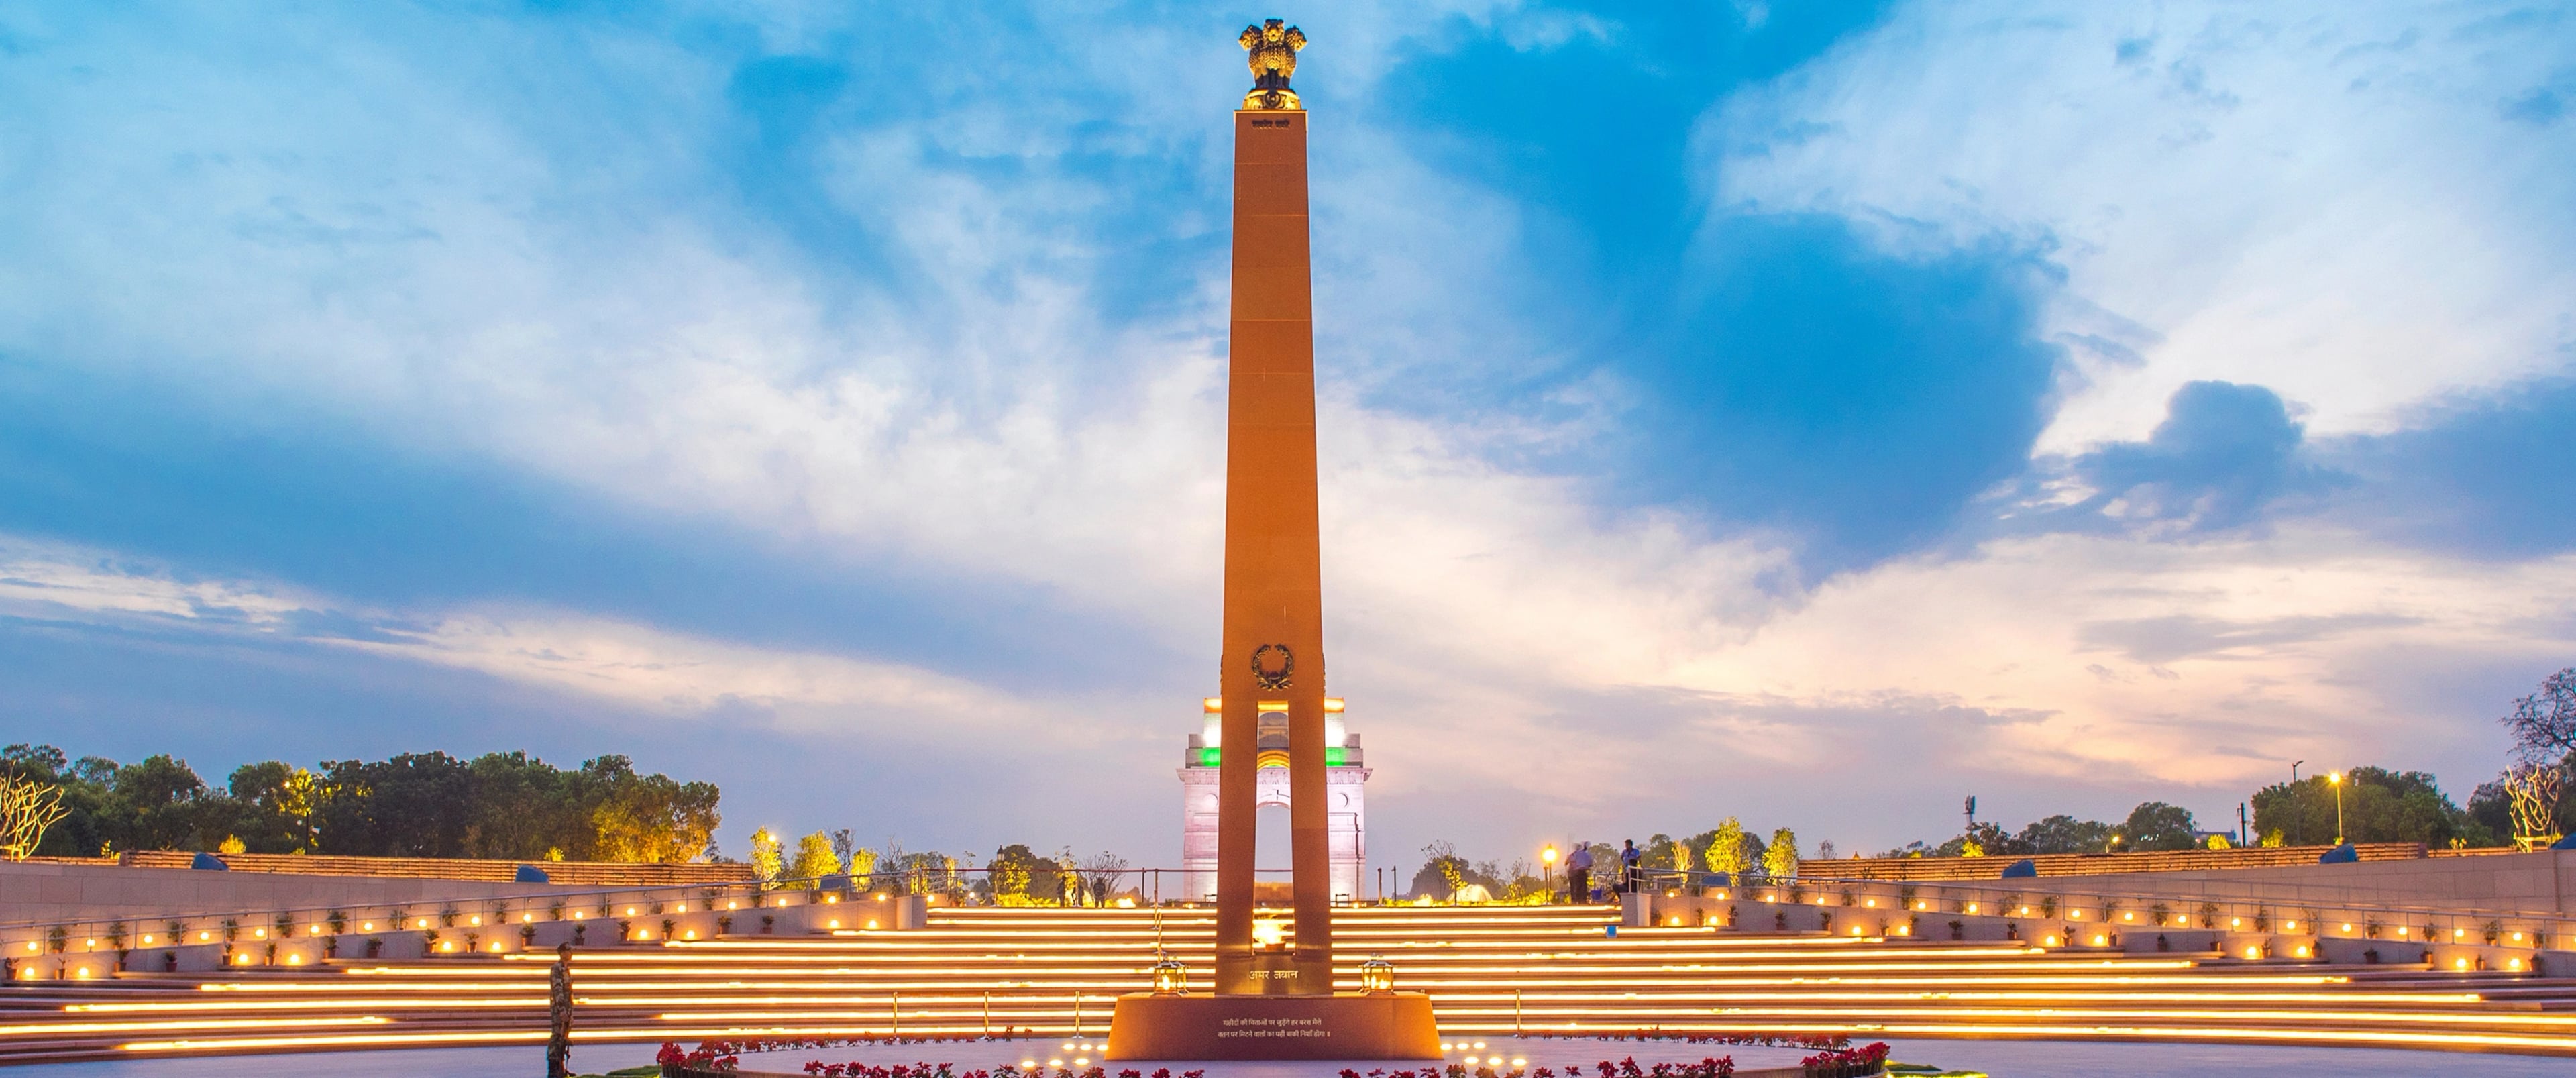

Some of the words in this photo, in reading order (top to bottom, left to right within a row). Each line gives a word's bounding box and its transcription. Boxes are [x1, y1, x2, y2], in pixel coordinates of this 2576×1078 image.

[1249, 970, 1270, 979] अमर
[1273, 970, 1299, 979] जवान
[1275, 1030, 1285, 1038] यही
